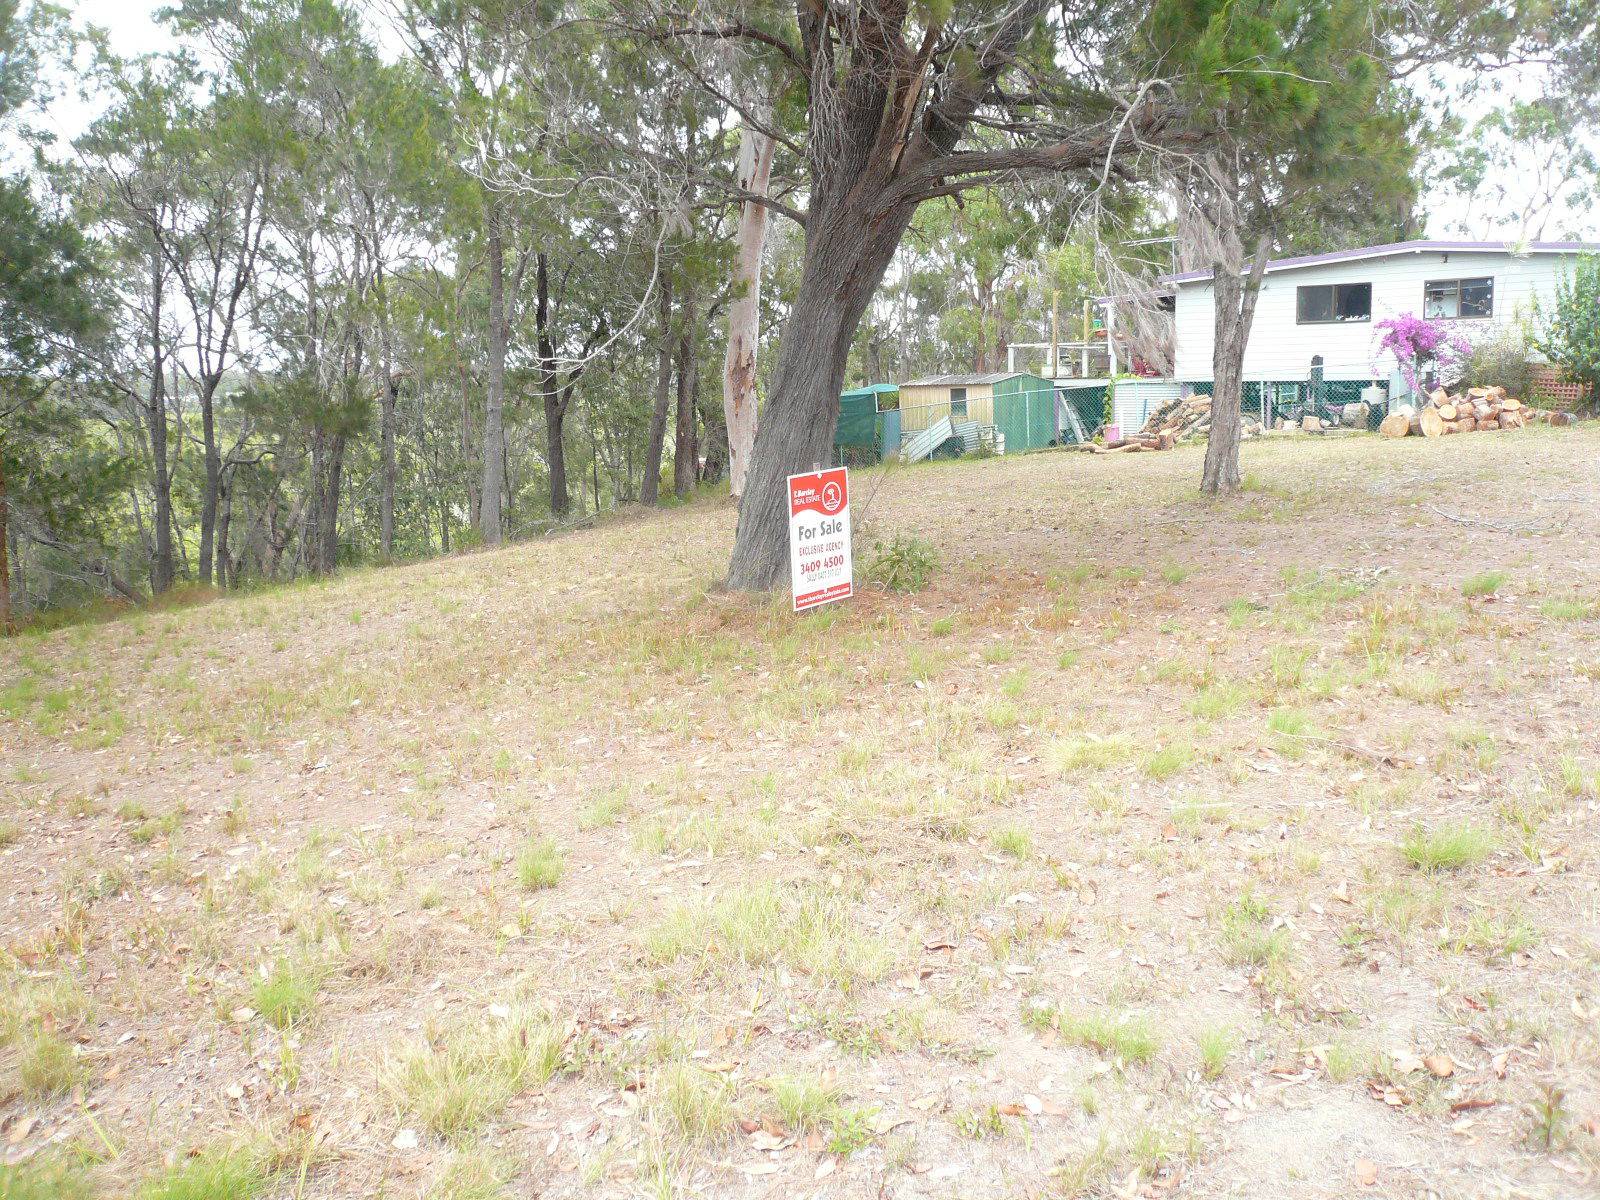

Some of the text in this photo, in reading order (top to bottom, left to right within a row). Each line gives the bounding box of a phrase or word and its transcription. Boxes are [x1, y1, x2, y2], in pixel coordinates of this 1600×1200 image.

[799, 519, 843, 542] For Sale
[799, 540, 844, 557] EXCLUSIVE AGENCY
[800, 559, 821, 576] 3409
[823, 554, 844, 569] 4500
